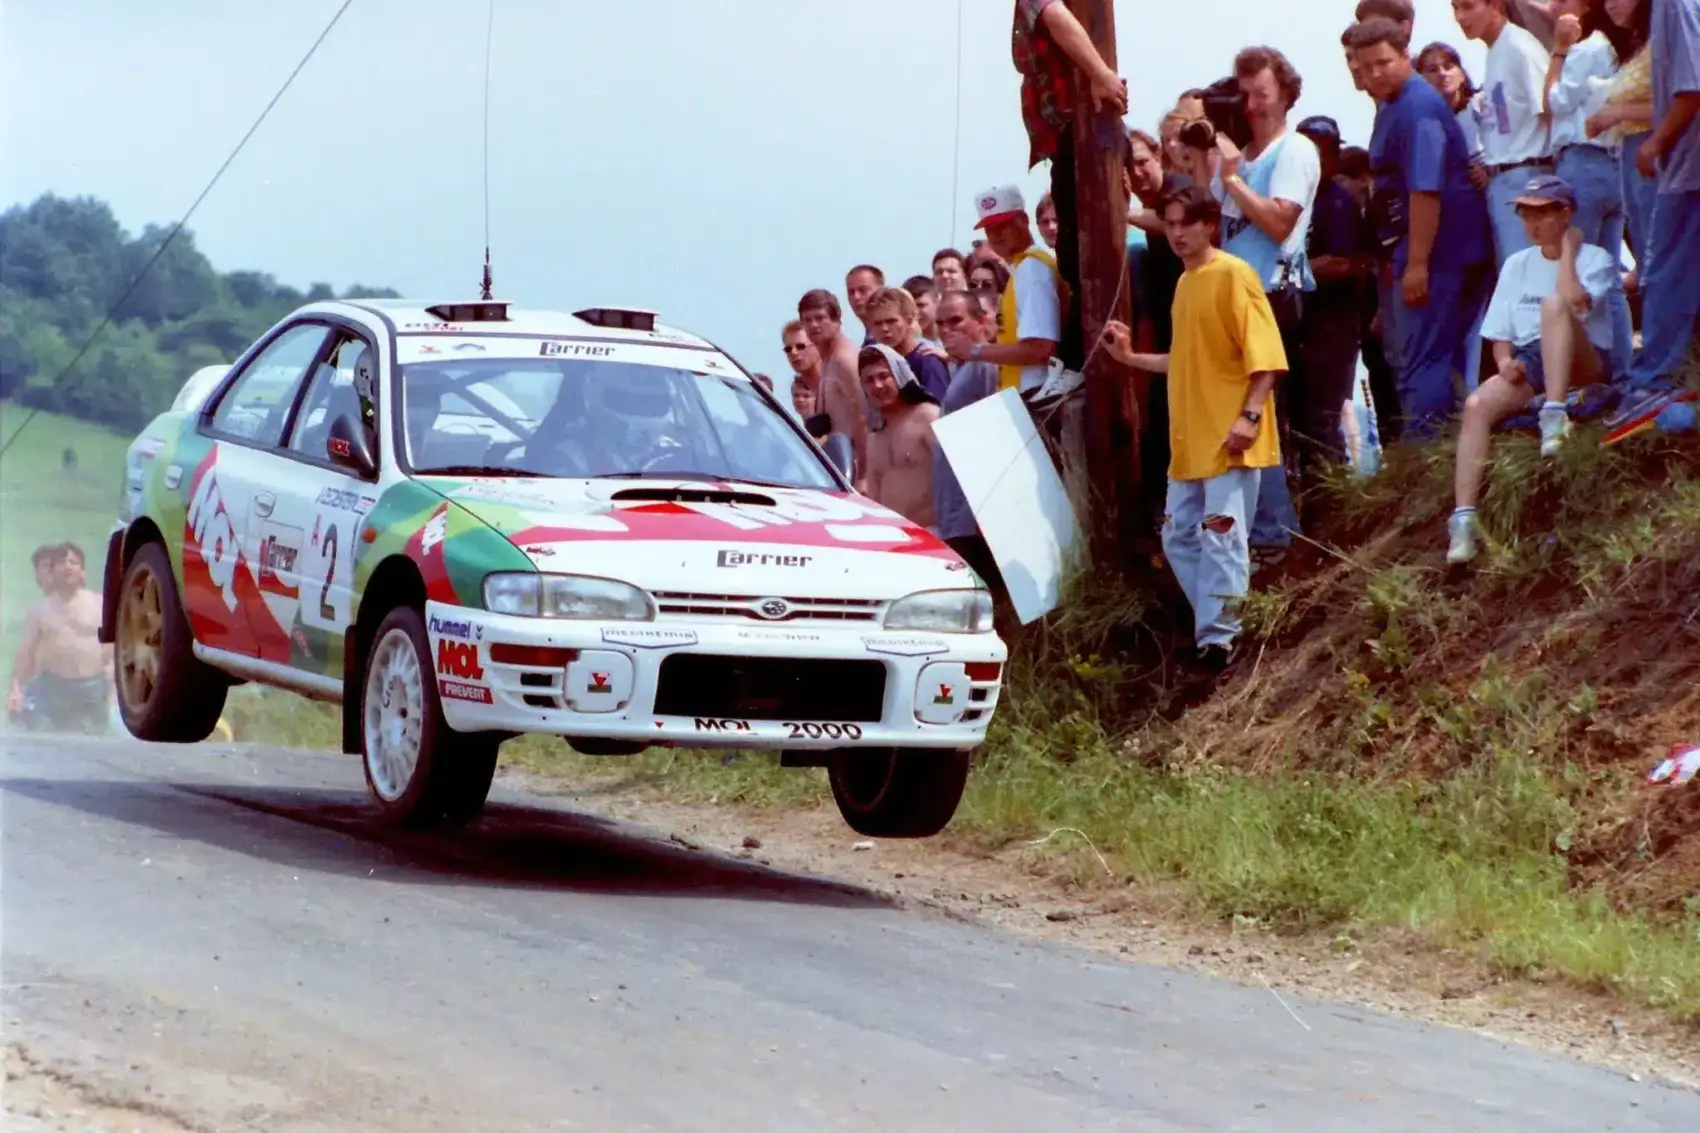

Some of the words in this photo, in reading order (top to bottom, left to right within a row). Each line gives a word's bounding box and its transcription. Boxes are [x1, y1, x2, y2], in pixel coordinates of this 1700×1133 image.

[540, 341, 616, 356] Carrier
[717, 550, 813, 568] Carrier
[320, 523, 338, 621] 2
[438, 638, 484, 681] MOL
[694, 717, 758, 736] MOL
[782, 722, 862, 741] 2000
